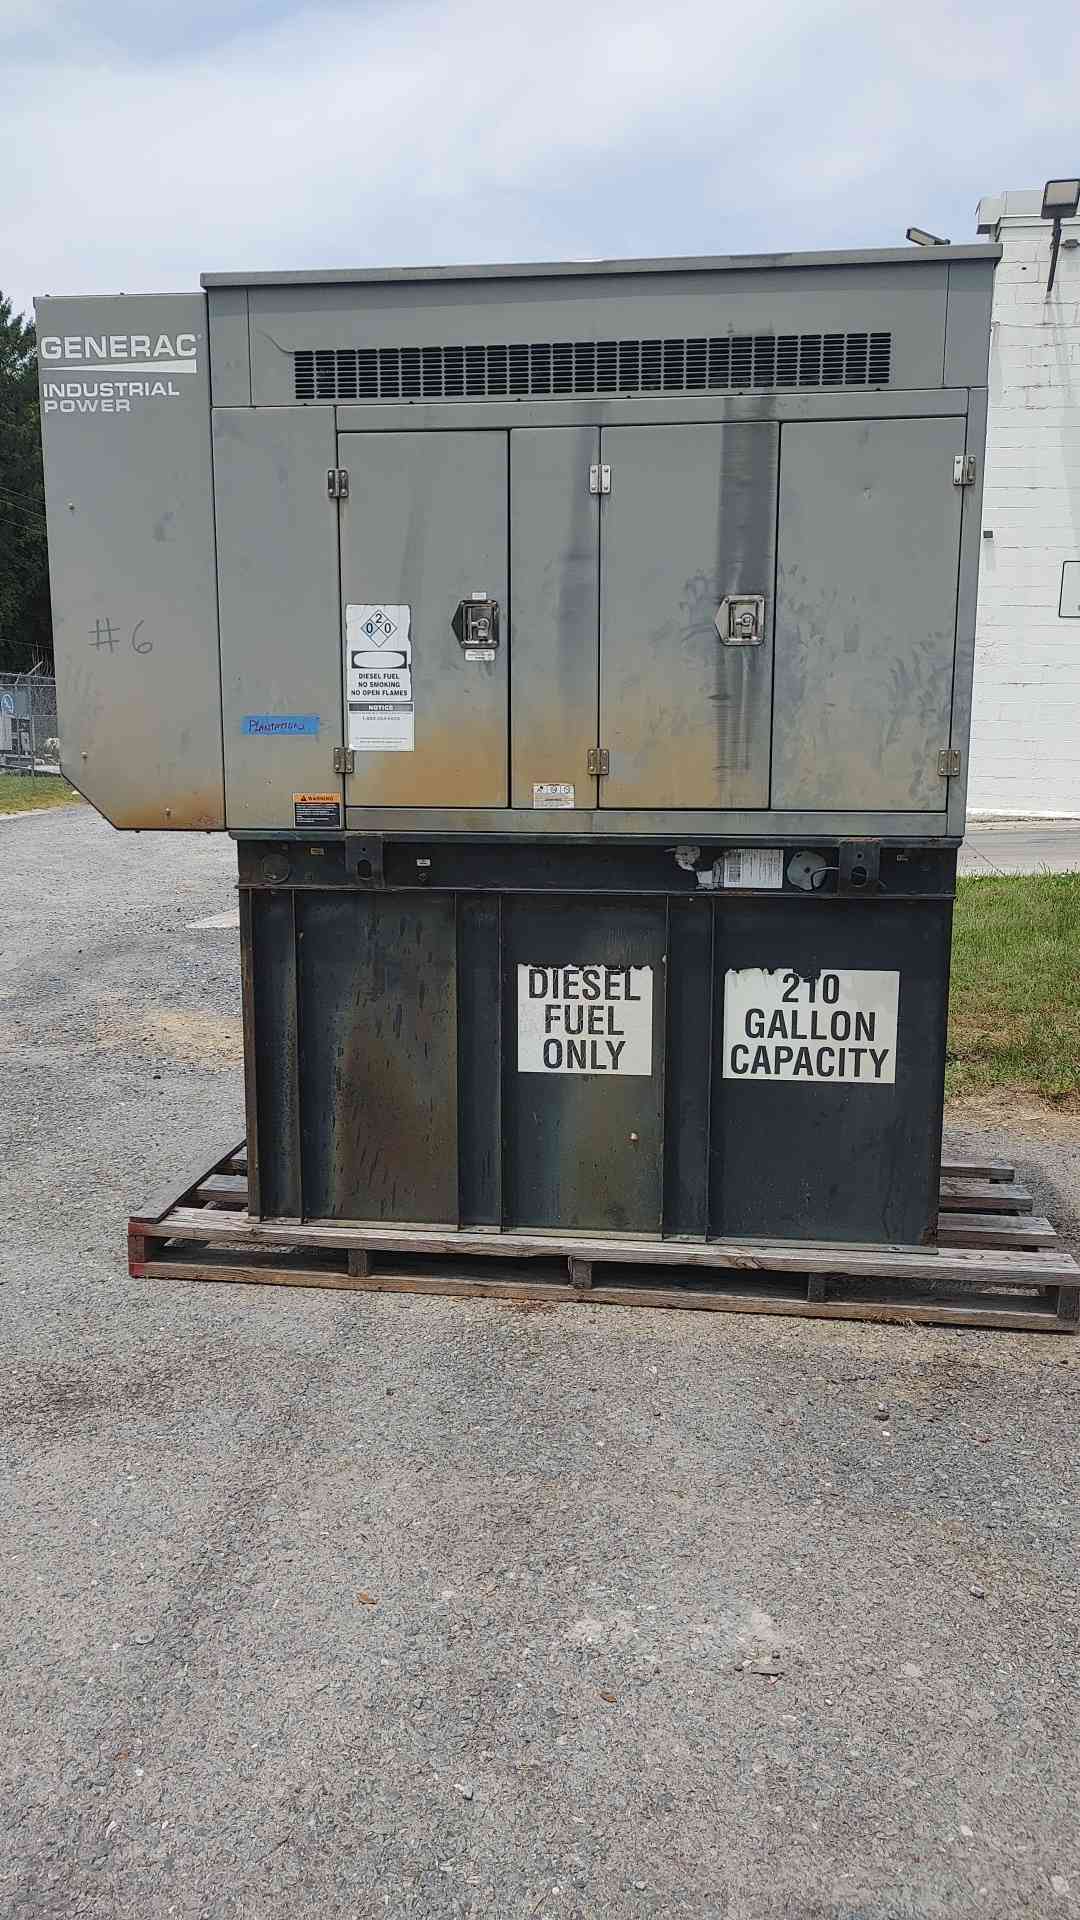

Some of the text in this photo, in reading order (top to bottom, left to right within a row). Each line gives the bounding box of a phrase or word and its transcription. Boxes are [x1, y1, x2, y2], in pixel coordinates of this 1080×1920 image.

[40, 333, 197, 360] GENERAC
[43, 382, 180, 398] INDUSTRIAL
[44, 399, 131, 413] POWER
[366, 622, 392, 634] 0 0
[375, 613, 383, 624] 2
[382, 689, 408, 697] FLAMES
[528, 968, 641, 1001] DIESEL
[781, 973, 840, 1004] 210
[544, 1004, 625, 1036] FUEL
[744, 1008, 876, 1041] GALLON
[543, 1038, 626, 1070] ONLY
[730, 1044, 889, 1078] CAPACITY
